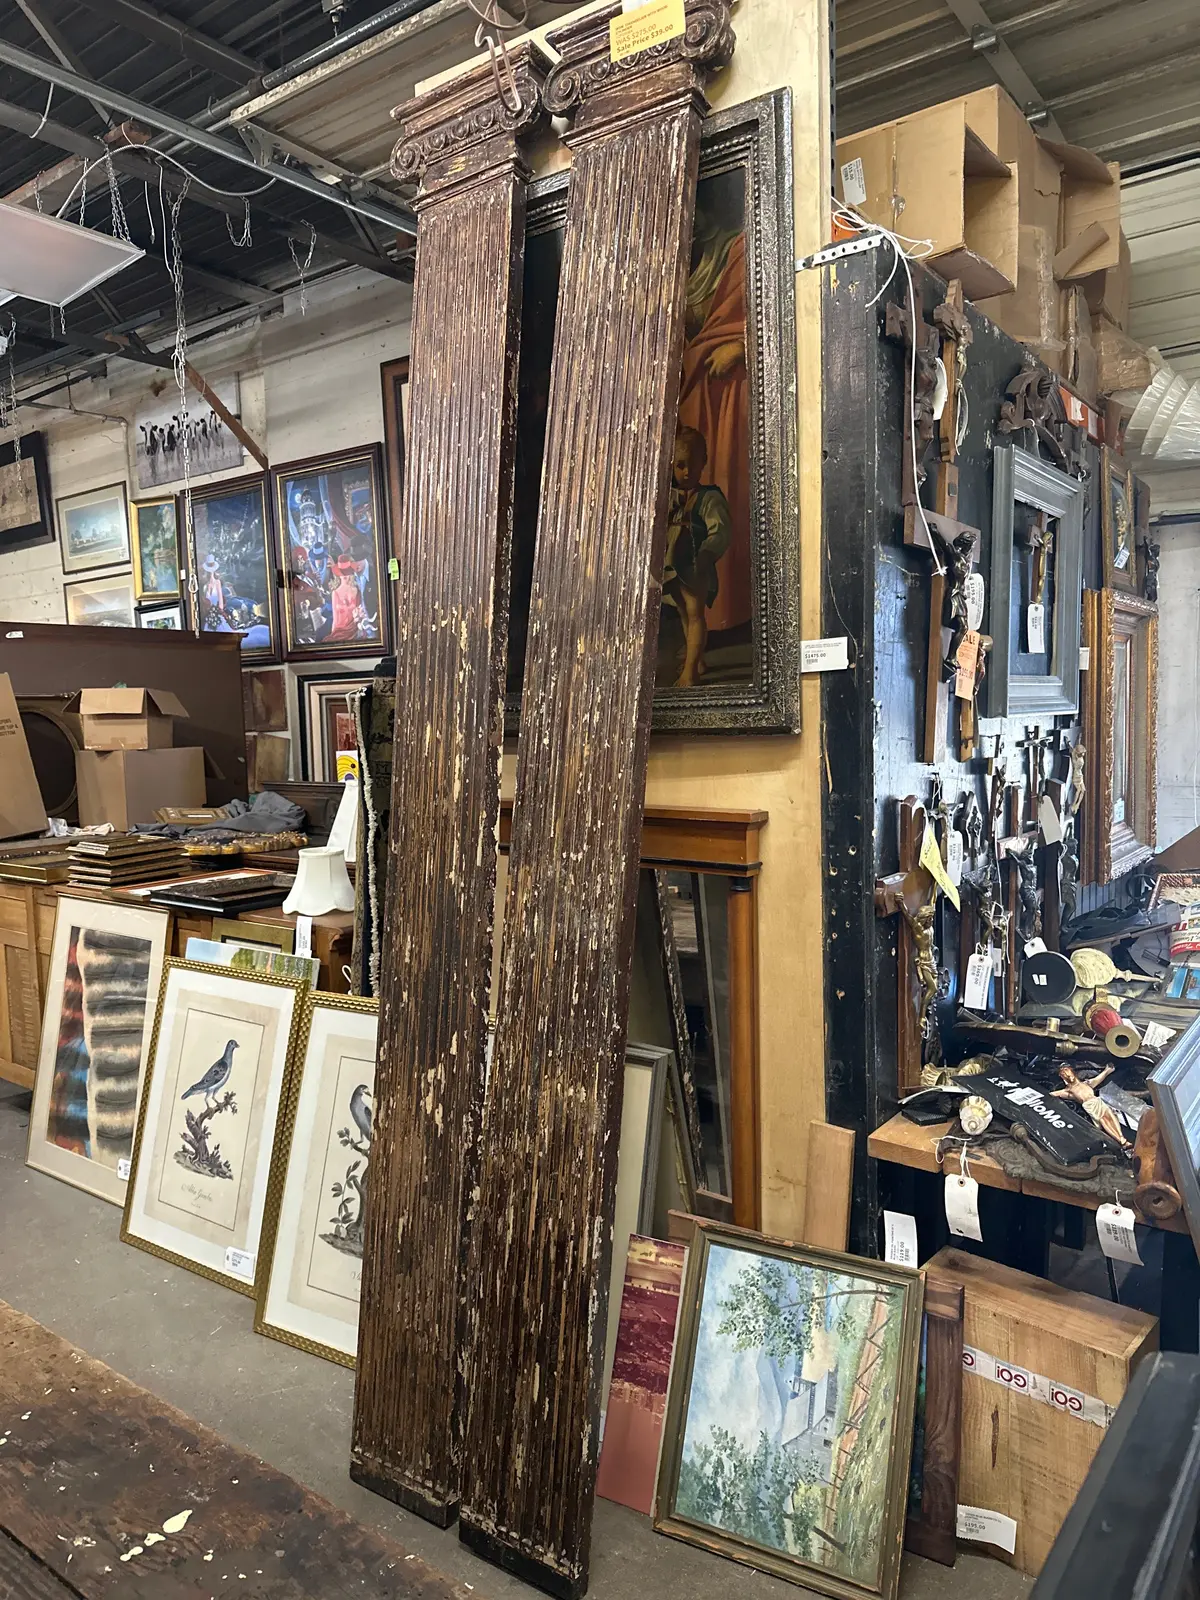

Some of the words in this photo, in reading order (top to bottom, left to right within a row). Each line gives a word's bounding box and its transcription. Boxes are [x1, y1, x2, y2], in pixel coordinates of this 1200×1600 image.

[615, 35, 630, 46] WAS
[632, 23, 657, 40] $275.00
[616, 42, 631, 53] Sale
[632, 34, 650, 46] Price
[651, 23, 674, 39] $39.00
